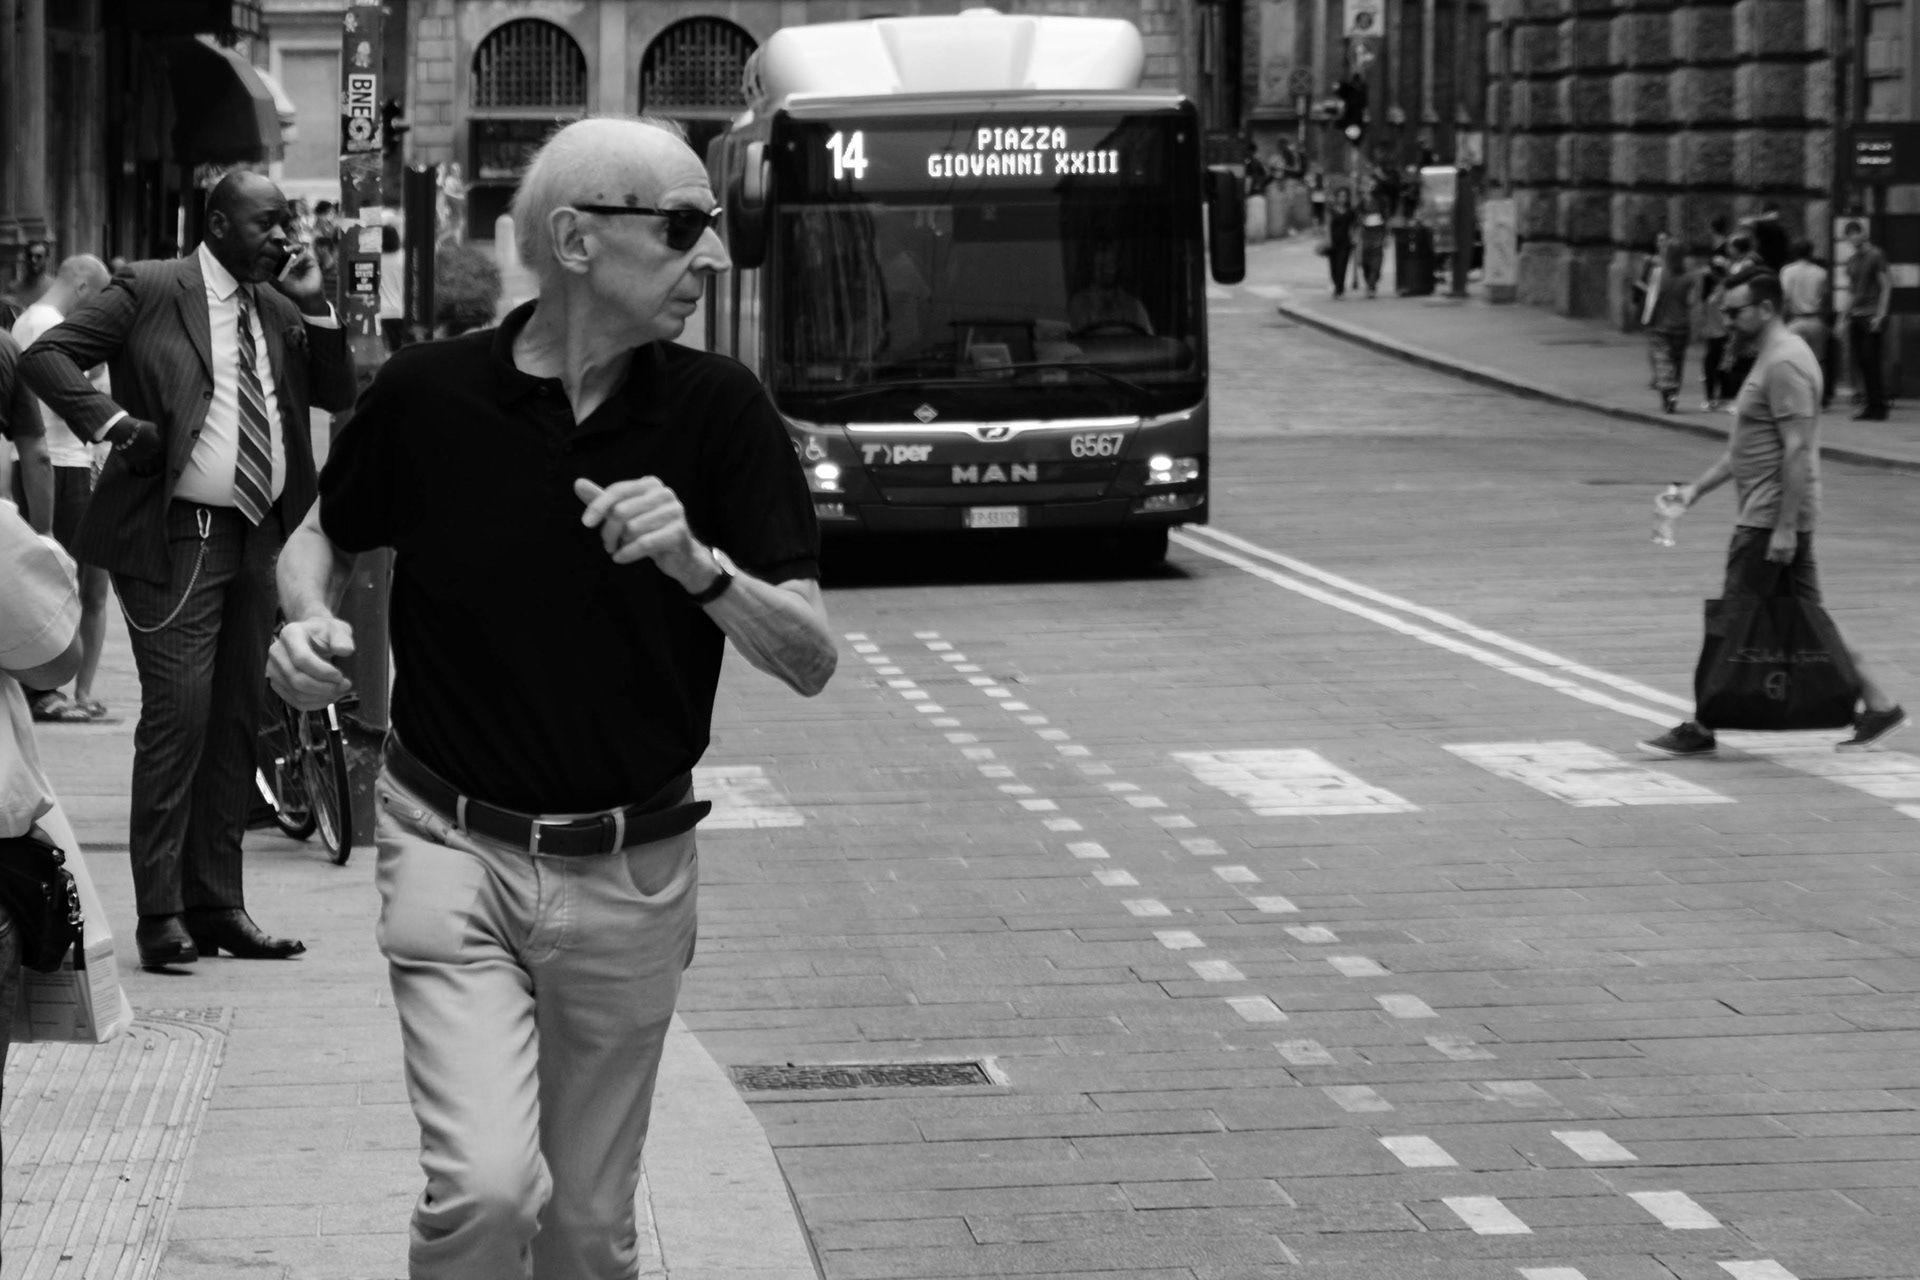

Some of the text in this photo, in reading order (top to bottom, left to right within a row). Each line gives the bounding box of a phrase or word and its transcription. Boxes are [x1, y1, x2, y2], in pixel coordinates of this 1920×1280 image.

[352, 79, 372, 118] BNE
[977, 127, 1067, 150] PIAZZA
[825, 130, 868, 180] 14
[928, 150, 1119, 177] GIOVANNI XXIII
[1070, 433, 1124, 458] 6567
[952, 463, 1038, 484] MAN
